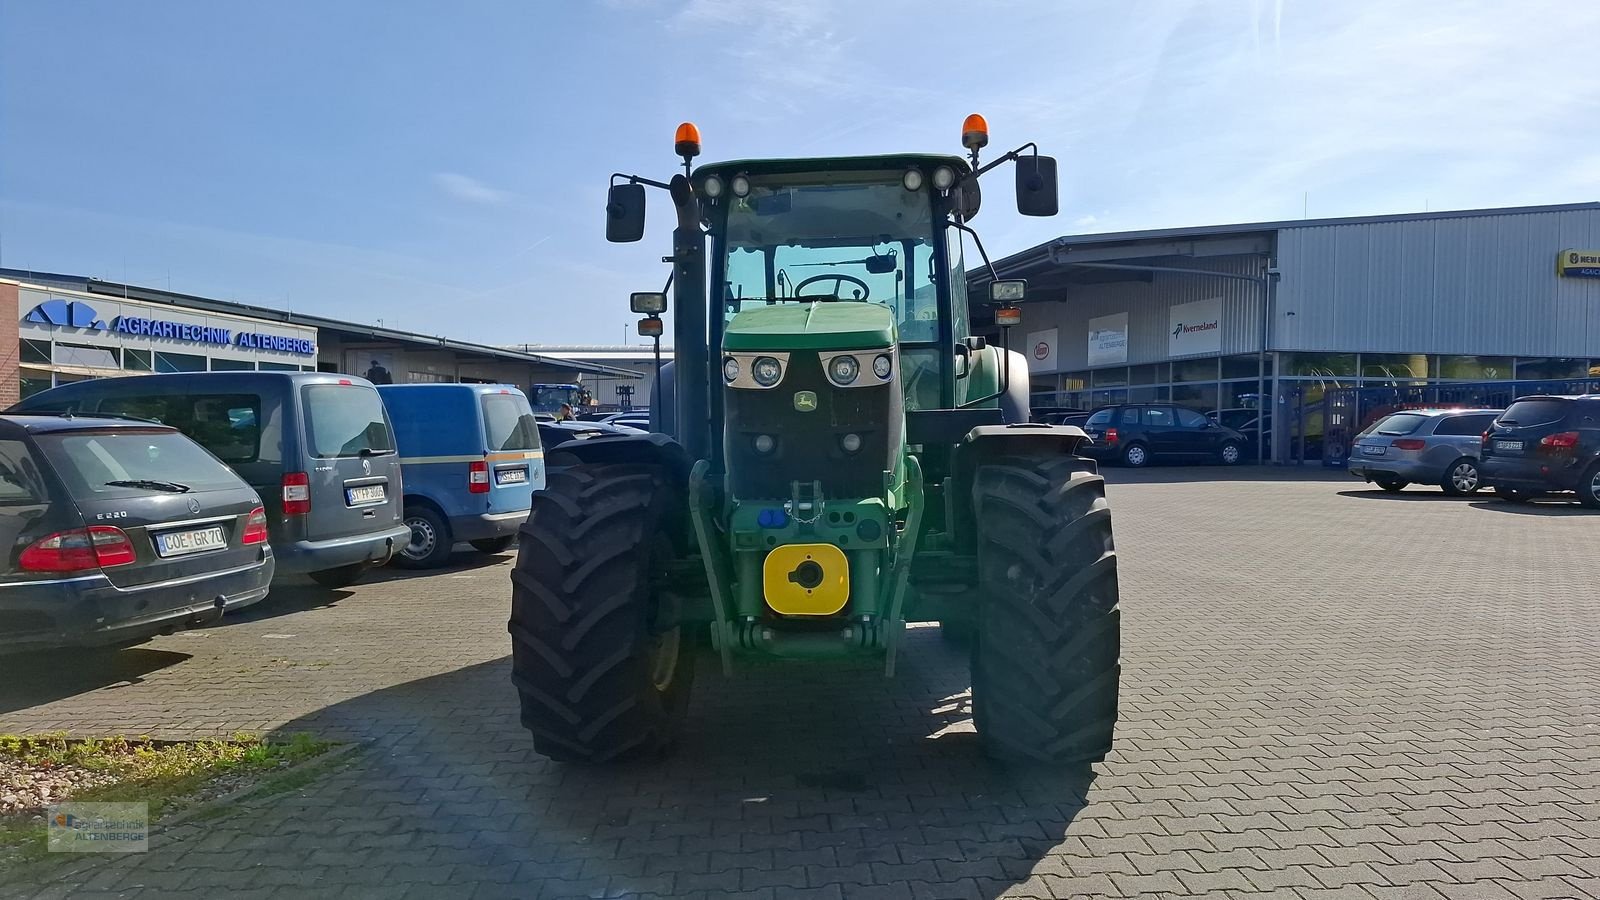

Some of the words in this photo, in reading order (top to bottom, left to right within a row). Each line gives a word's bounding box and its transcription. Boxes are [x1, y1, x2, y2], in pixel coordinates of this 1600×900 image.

[1183, 319, 1218, 333] Kverneland
[116, 316, 233, 345] AGRARTECHNIK
[239, 332, 315, 355] ALTENBERGE
[106, 511, 127, 519] 220
[165, 534, 189, 550] COE
[194, 532, 209, 545] GR
